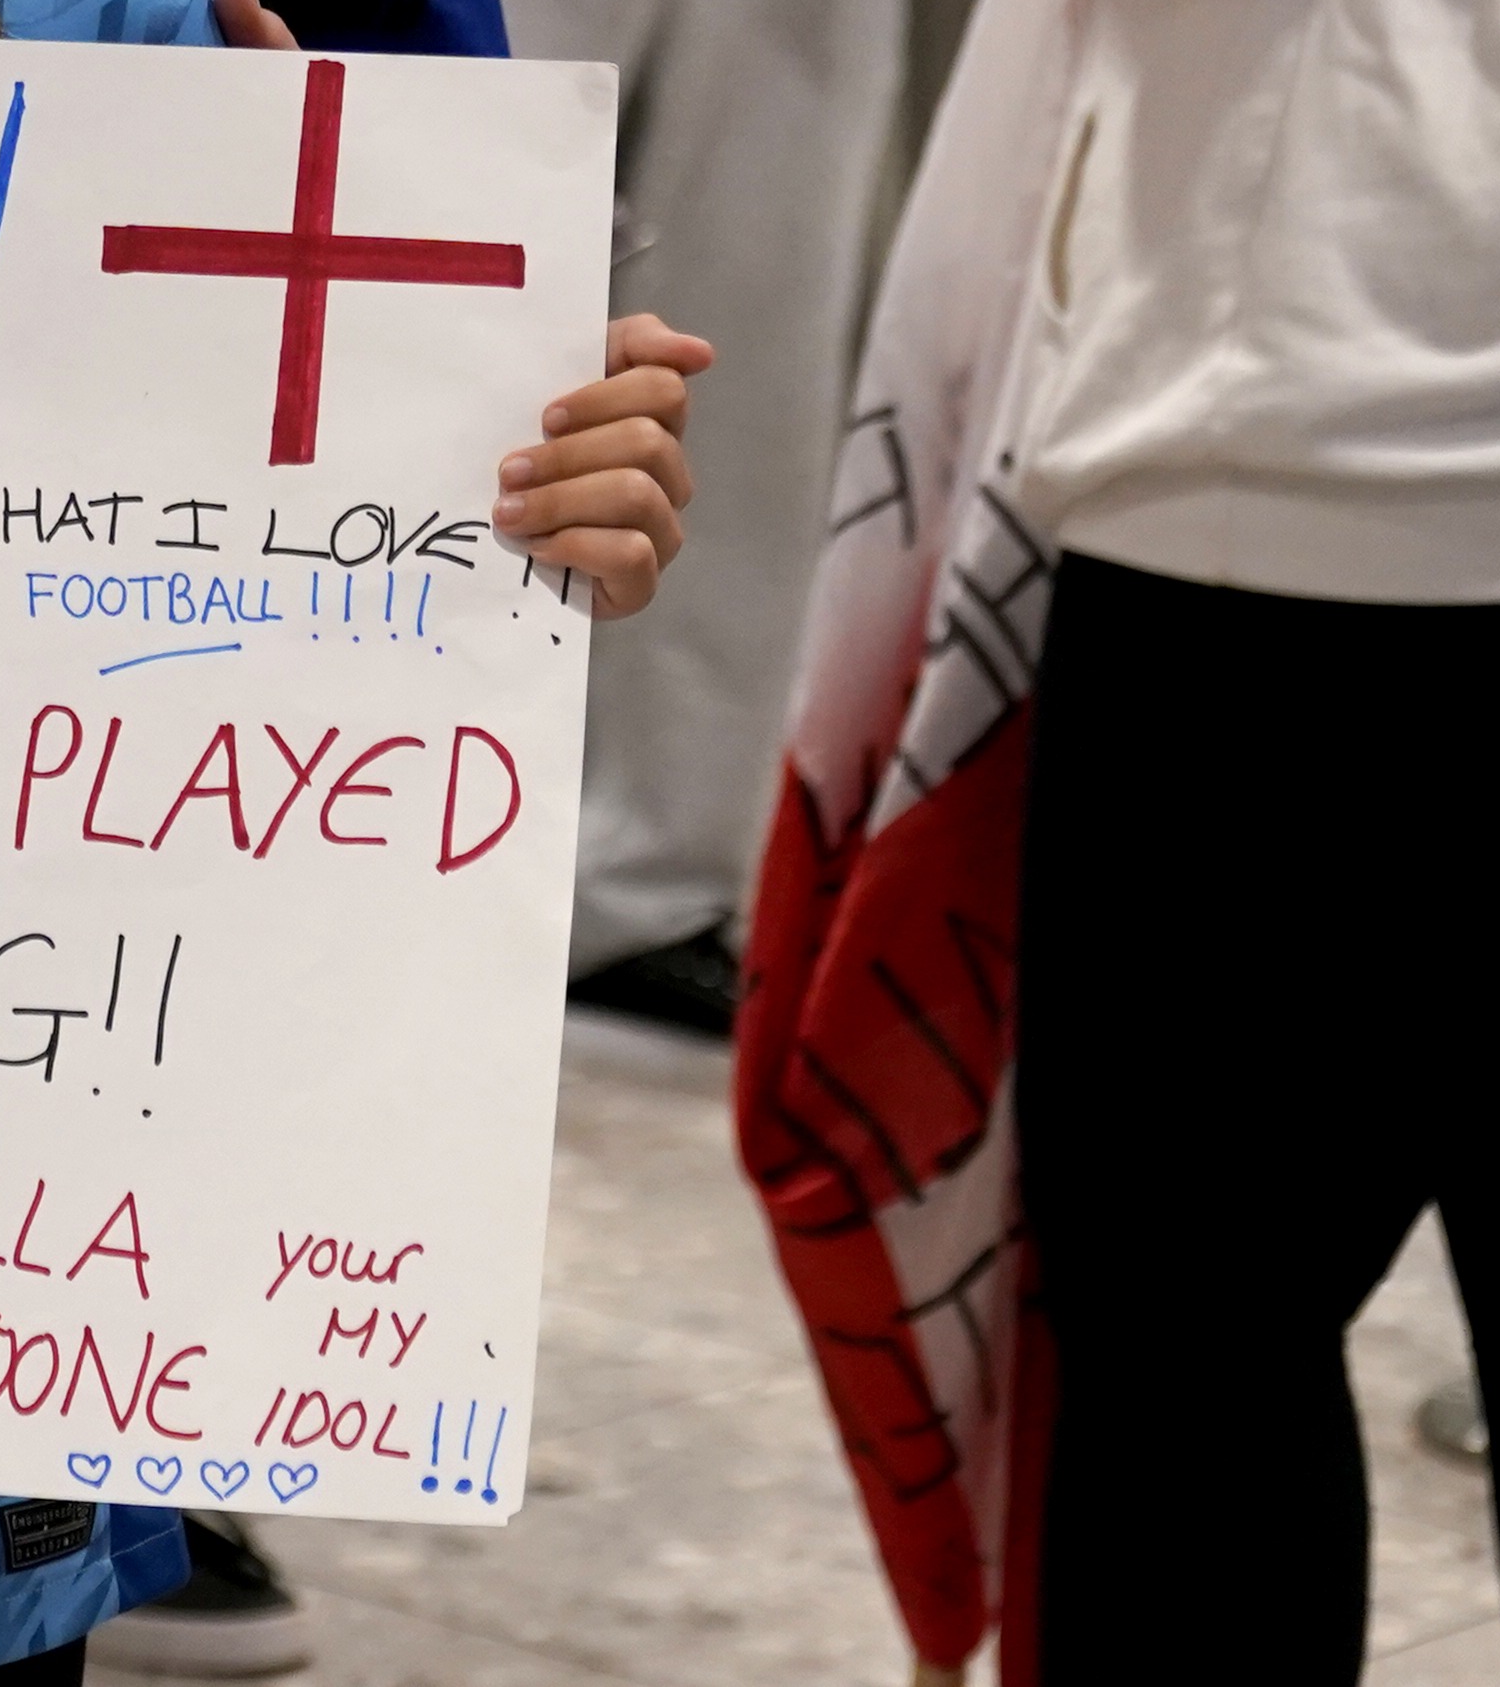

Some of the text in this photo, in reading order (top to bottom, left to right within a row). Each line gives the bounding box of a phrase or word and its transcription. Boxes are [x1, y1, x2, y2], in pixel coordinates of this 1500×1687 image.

[155, 499, 227, 551] I
[262, 503, 490, 570] LOVE
[15, 704, 521, 875] PLAYED
[266, 1231, 424, 1301] your
[319, 1307, 427, 1368] MY
